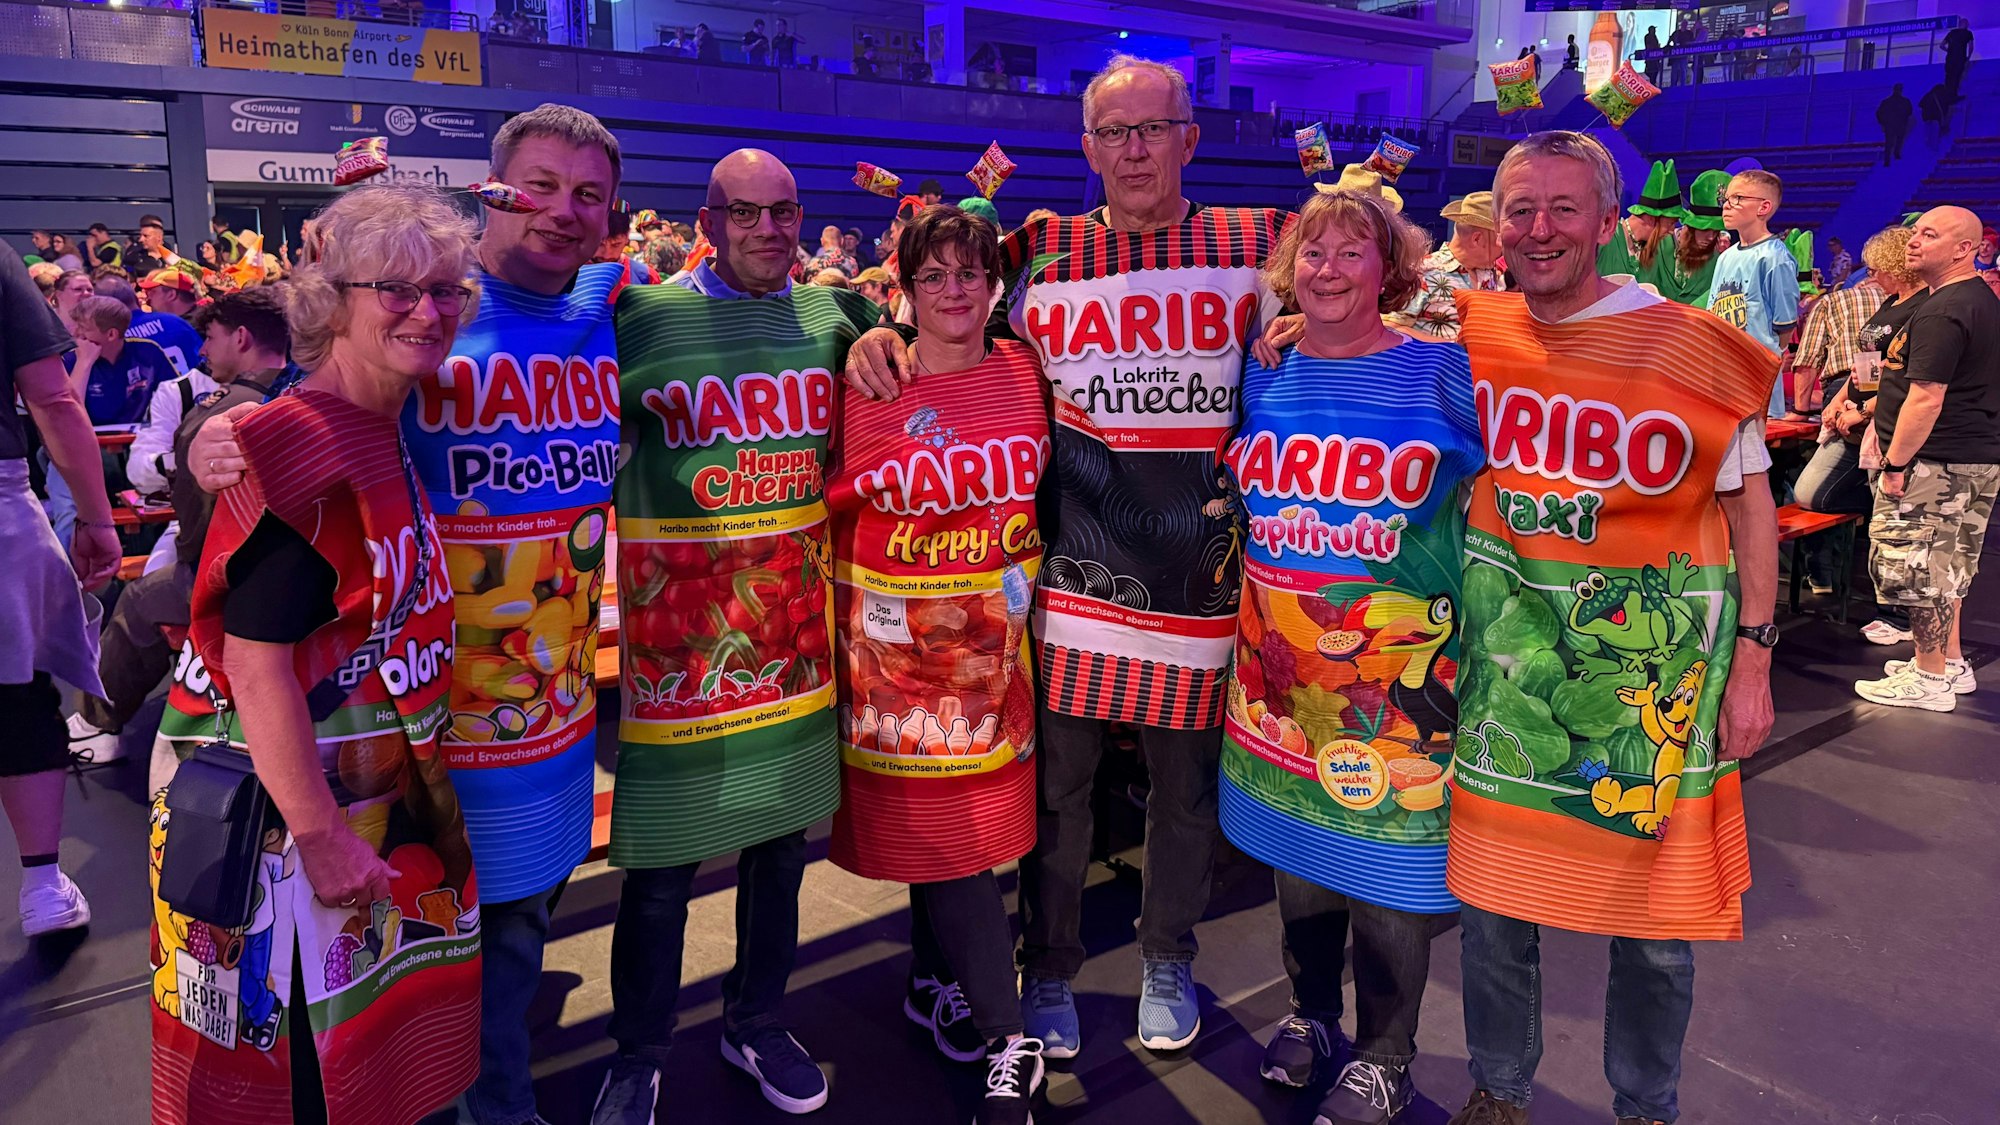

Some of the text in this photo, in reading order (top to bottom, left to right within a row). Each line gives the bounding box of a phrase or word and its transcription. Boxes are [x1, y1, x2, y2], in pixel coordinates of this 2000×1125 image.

[296, 24, 392, 41] Köln Bonn Airport
[218, 33, 471, 72] Heimathafen des VfL
[1490, 60, 1529, 78] HARIBO
[1617, 66, 1652, 100] HARIBO
[243, 104, 302, 115] SCHWALBE
[431, 117, 475, 126] SCHWALBE
[231, 118, 300, 135] arena
[439, 131, 485, 139] Bergneustadt
[1383, 140, 1415, 158] HARIBO
[259, 161, 449, 186] Gumsbach
[1008, 265, 1031, 305] eggie
[1113, 366, 1180, 383] Lakritz
[418, 357, 620, 430] HARIBO
[1058, 373, 1239, 414] chnecke
[645, 371, 832, 445] HARIB
[1058, 405, 1081, 421] Haribo
[1120, 433, 1139, 442] froh
[1477, 388, 1687, 488] RIBO
[737, 448, 816, 476] Happy
[692, 463, 824, 509] Cherri
[454, 521, 493, 533] macht
[497, 520, 534, 532] Kinder
[537, 517, 556, 529] froh
[659, 524, 689, 534] Haribo
[691, 522, 720, 533] macht
[723, 519, 755, 532] Kinder
[758, 516, 777, 528] froh
[1496, 488, 1600, 540] axi
[886, 512, 1041, 568] Happy-Co
[1252, 510, 1398, 558] opifrutti
[1465, 534, 1482, 546] acht
[1483, 540, 1508, 558] Kinder
[864, 574, 888, 588] Haribo
[890, 580, 917, 591] macht
[920, 579, 950, 590] Kinder
[953, 579, 972, 588] froh
[1257, 567, 1274, 581] Kinder
[1276, 573, 1293, 584] froh
[868, 612, 901, 627] Original
[876, 603, 891, 615] Das
[1048, 598, 1163, 628] und Erwachsene ebenso!
[672, 727, 692, 738] und
[696, 716, 752, 735] Erwachsene
[755, 707, 790, 722] ebenso!
[450, 728, 578, 762] und Erwachsene ebenso!
[1246, 737, 1282, 762] Erwachsene
[1284, 756, 1313, 775] ebenso!
[871, 759, 887, 769] und
[888, 761, 942, 772] Erwachsene
[944, 761, 982, 772] ebenso!
[1330, 761, 1371, 772] Schale
[1334, 774, 1372, 784] weicher
[1342, 786, 1371, 796] Kern
[1459, 772, 1499, 794] ebenso!
[390, 949, 442, 976] Erwachsene
[186, 979, 227, 1016] JEDEN
[184, 1002, 231, 1043] WAS DABEI
